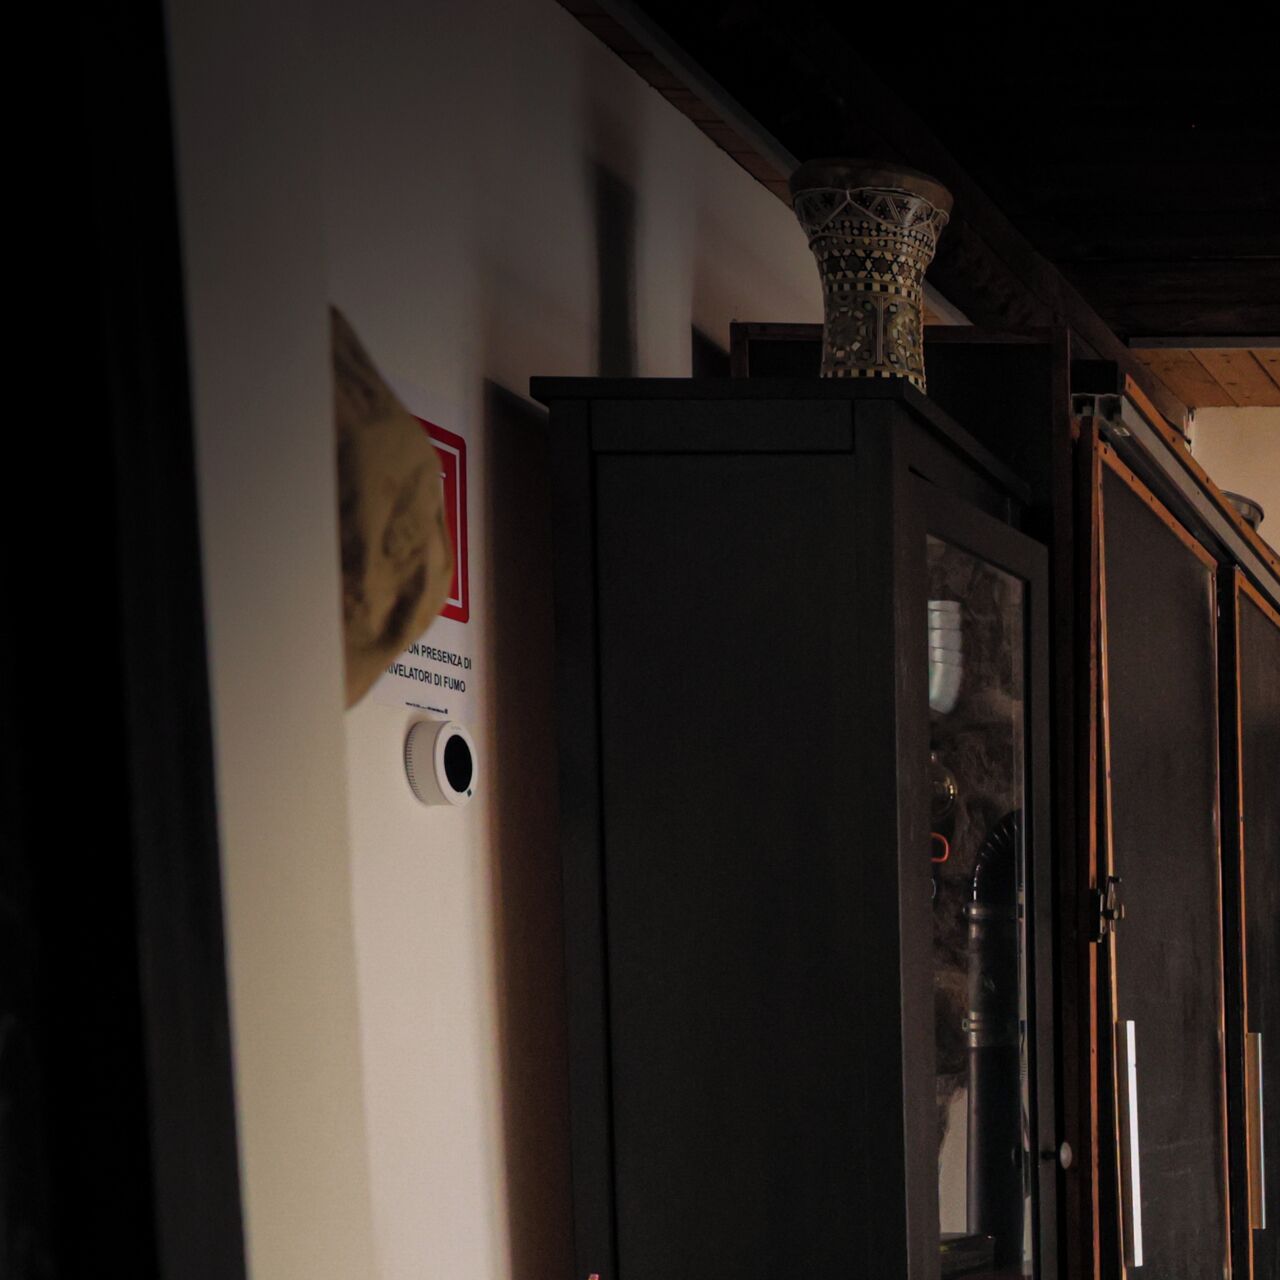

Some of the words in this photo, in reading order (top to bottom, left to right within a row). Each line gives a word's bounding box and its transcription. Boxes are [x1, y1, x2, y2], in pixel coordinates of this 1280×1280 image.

[421, 645, 463, 668] PRESENZA
[464, 657, 472, 670] DI
[434, 673, 442, 687] DI
[443, 676, 466, 693] FUMO
